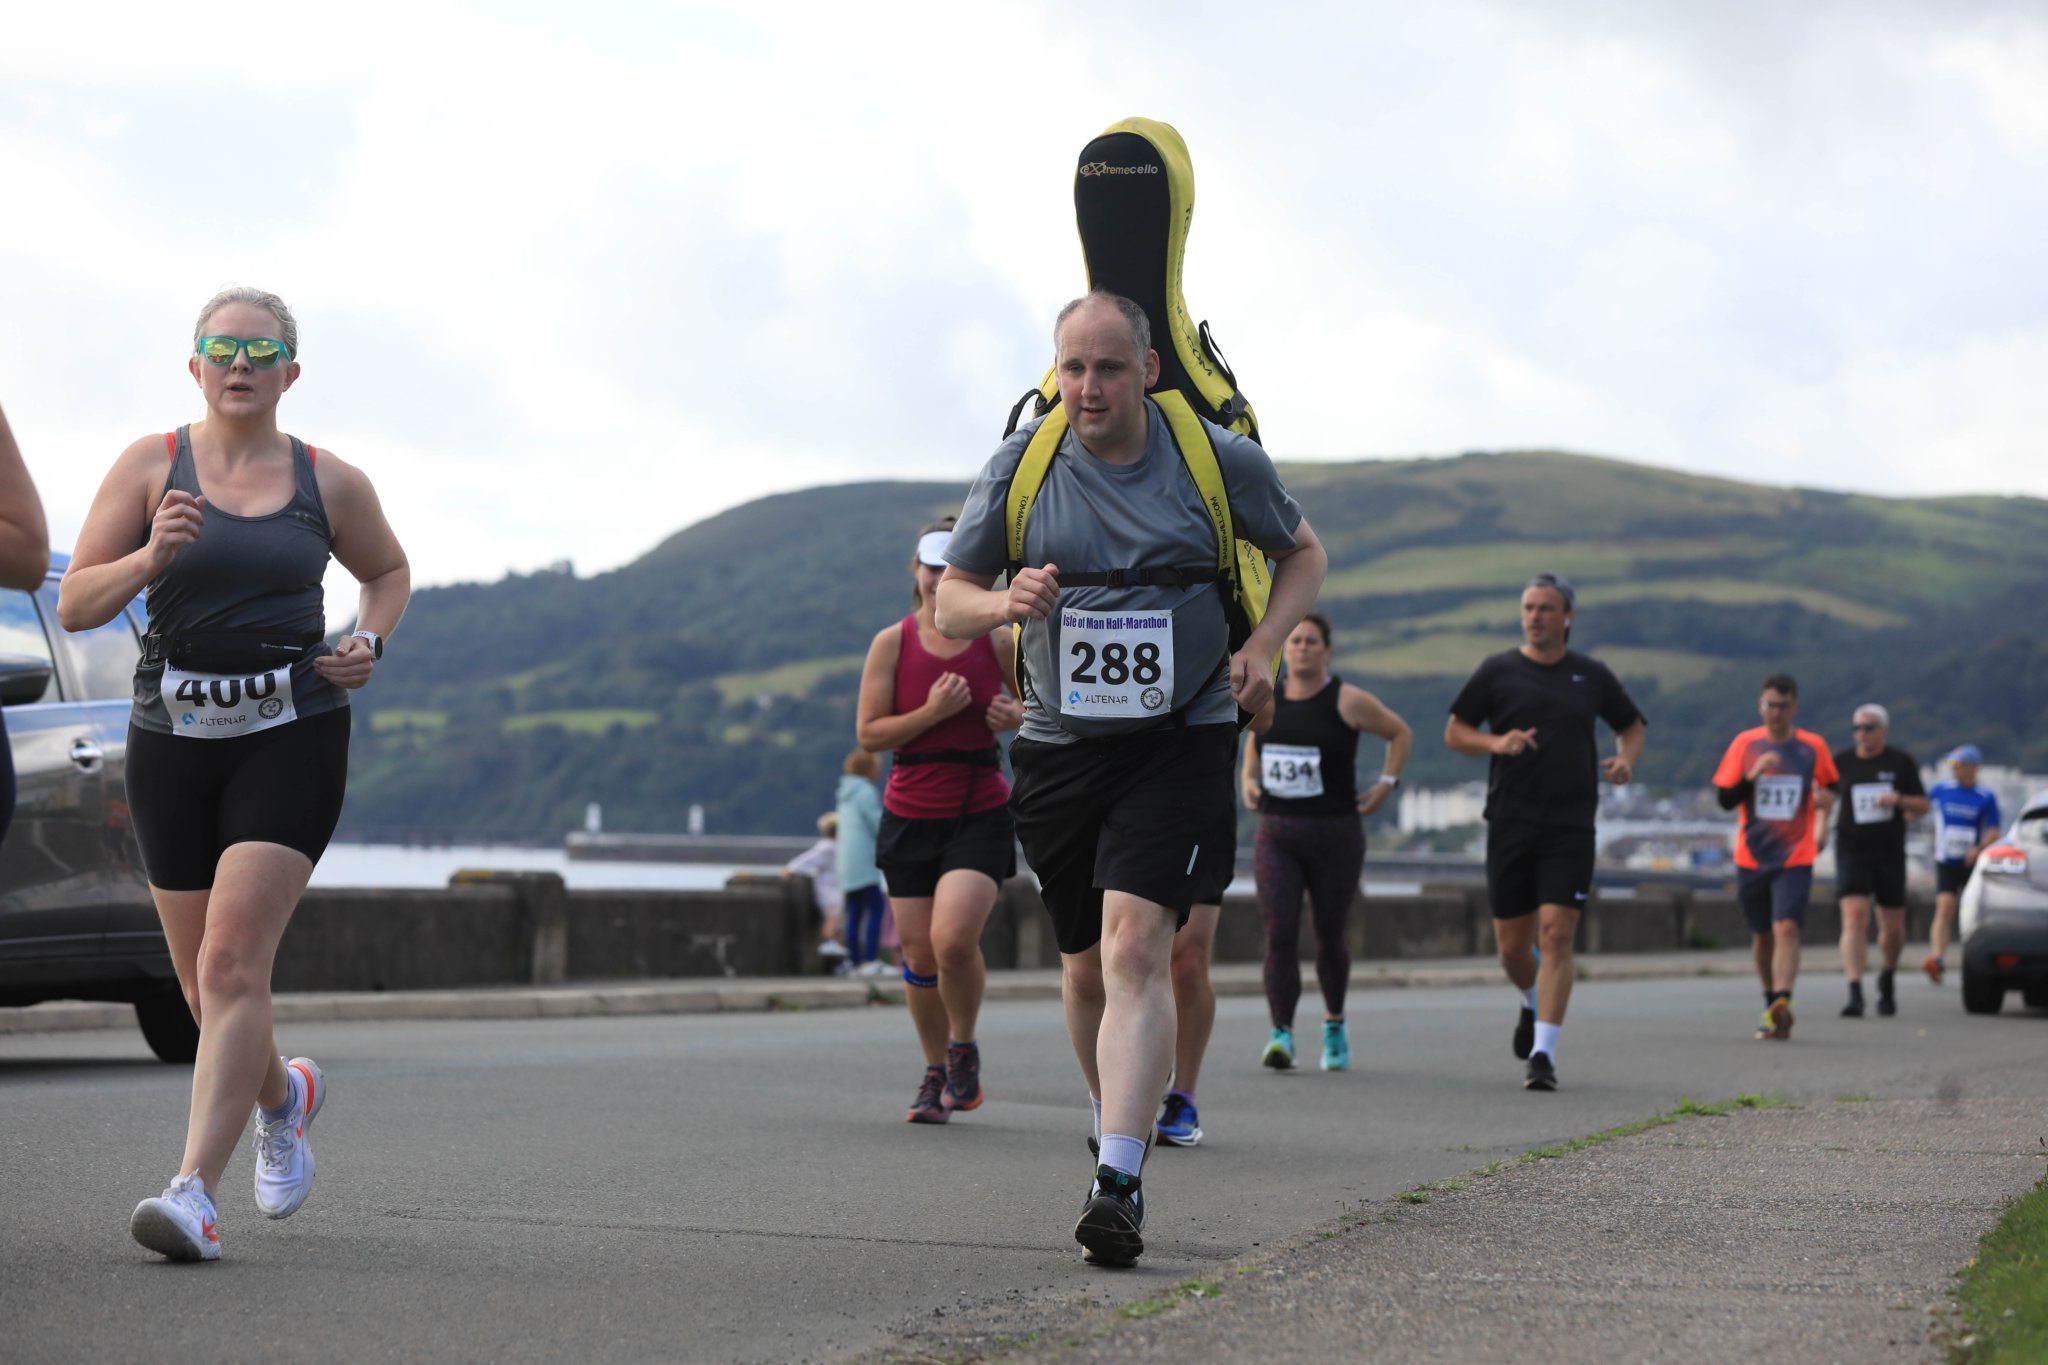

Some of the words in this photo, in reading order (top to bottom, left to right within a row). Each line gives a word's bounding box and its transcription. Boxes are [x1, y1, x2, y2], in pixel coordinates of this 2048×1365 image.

[1063, 615, 1077, 628] Isle
[1078, 617, 1086, 629] of
[1087, 618, 1105, 630] Man
[1106, 616, 1168, 630] Half-Marathon
[1071, 641, 1162, 686] 288
[175, 672, 277, 709] 400
[1084, 695, 1129, 704] ALTENAR
[199, 714, 247, 727] ALTENAR
[1268, 760, 1313, 782] 434
[1760, 787, 1797, 806] 217
